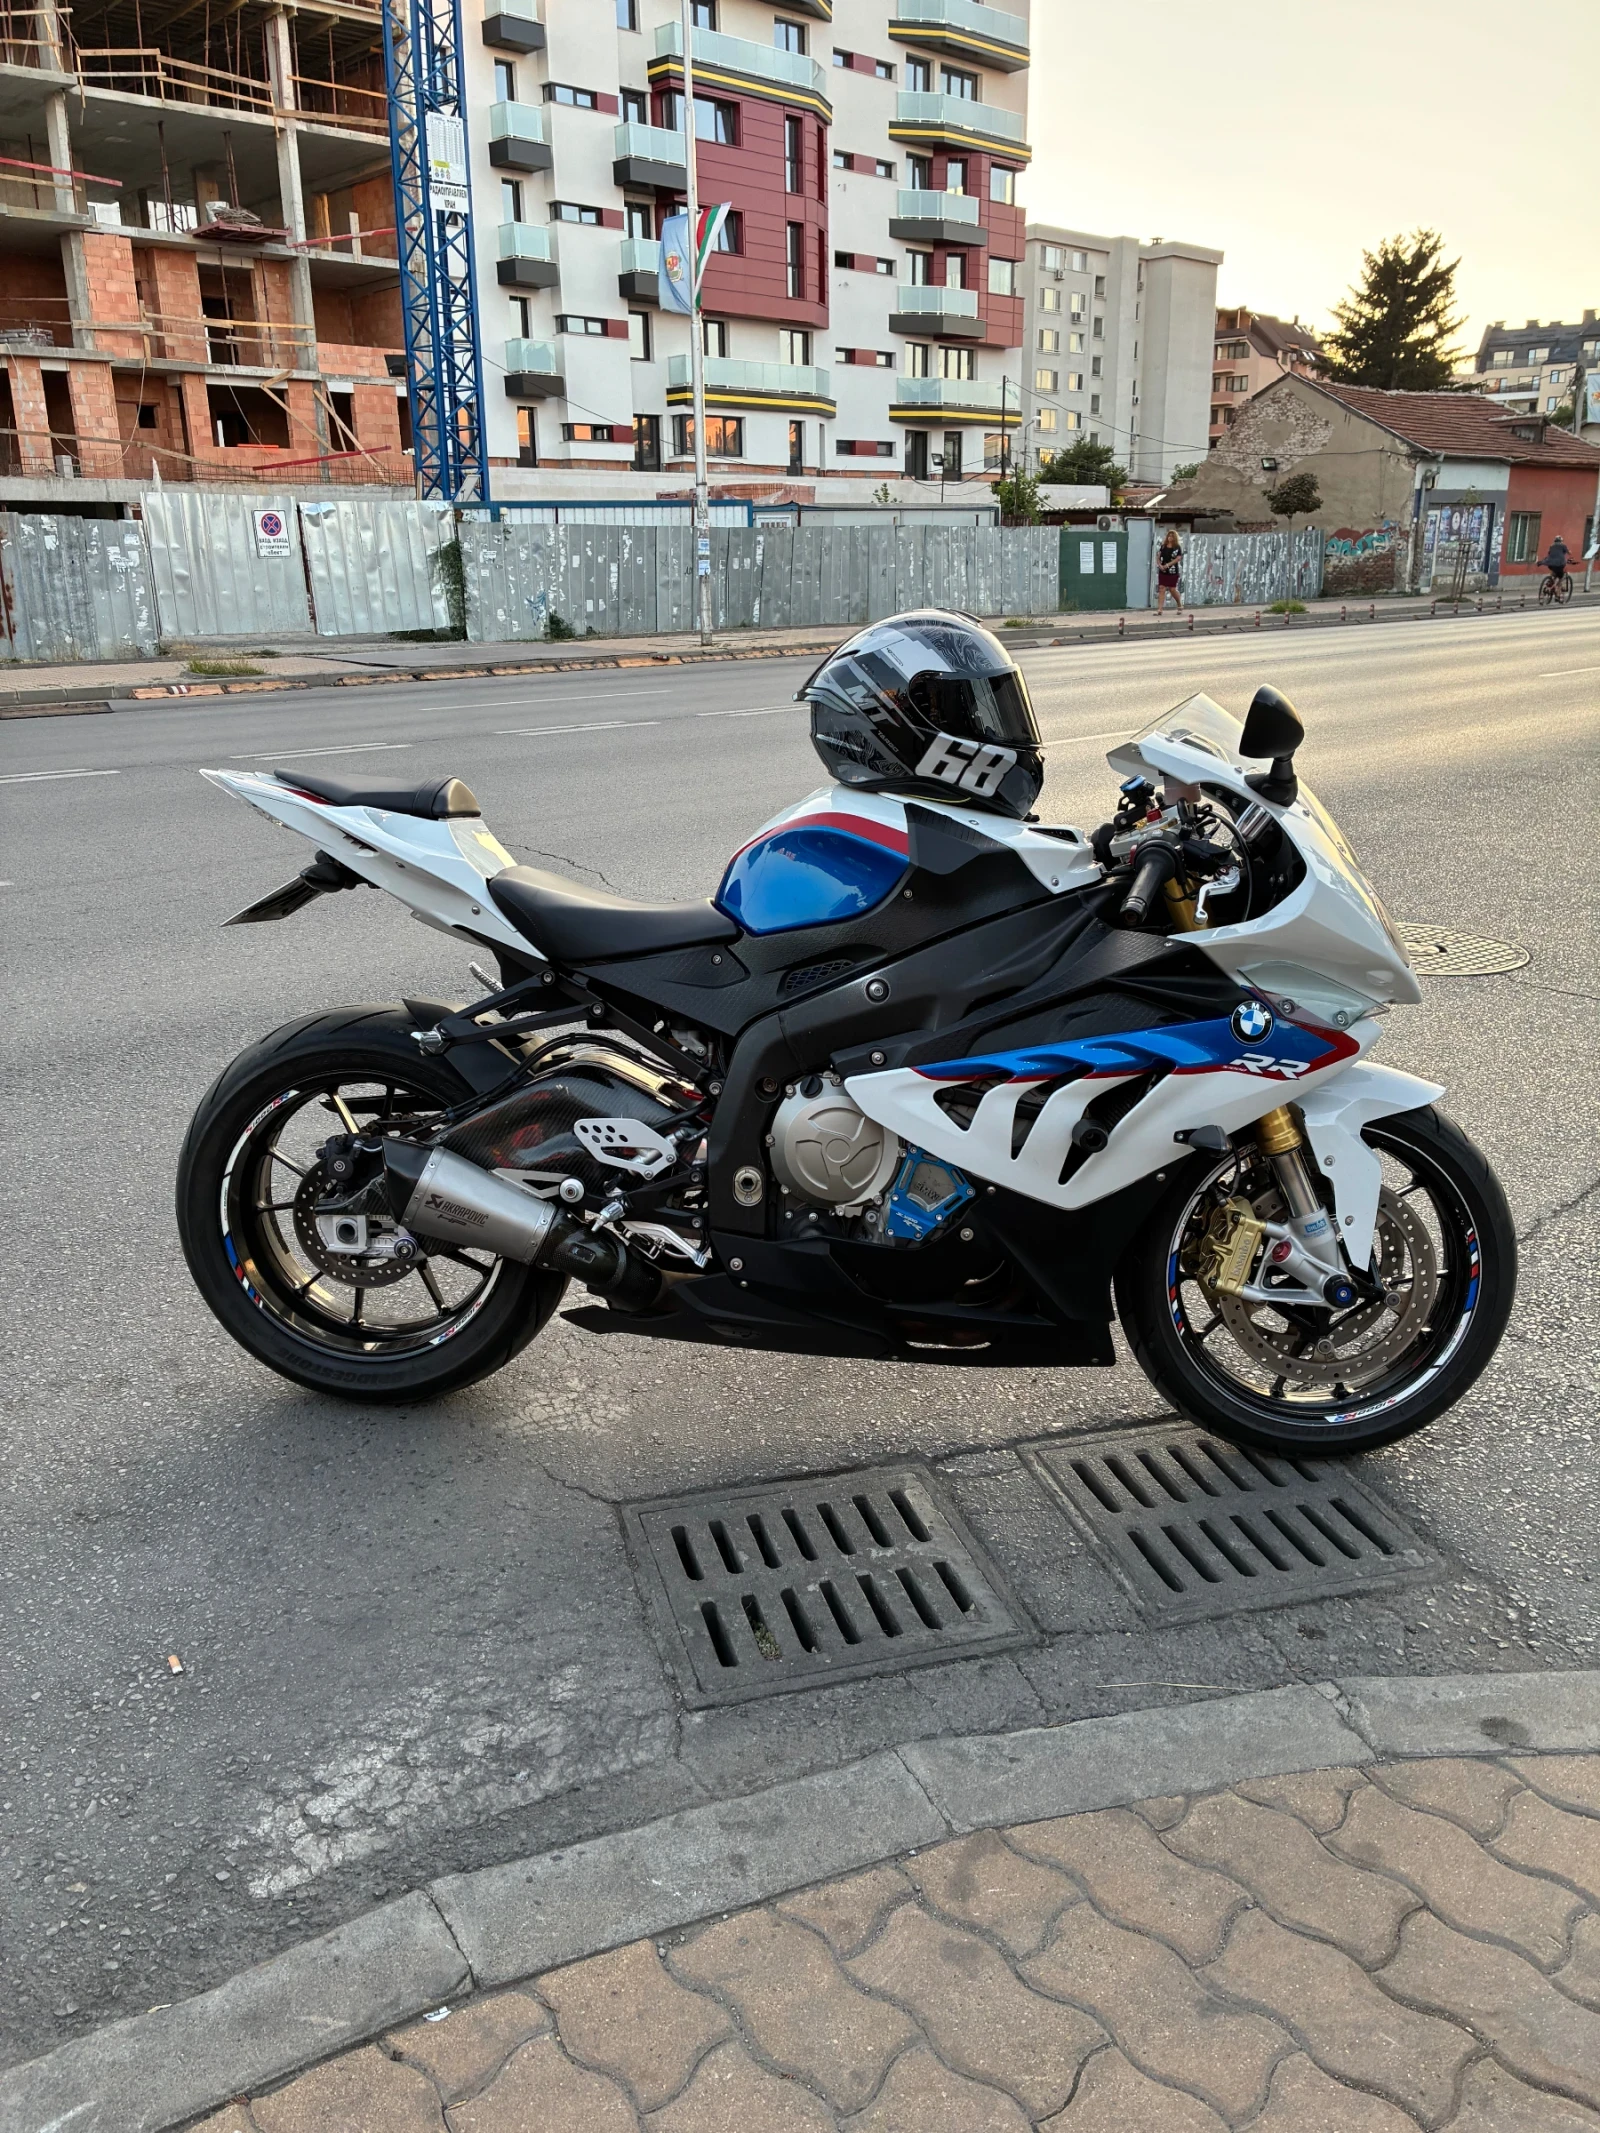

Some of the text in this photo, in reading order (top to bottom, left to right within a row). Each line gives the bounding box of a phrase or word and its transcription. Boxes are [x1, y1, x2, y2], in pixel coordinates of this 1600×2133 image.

[845, 684, 900, 728] MT
[914, 733, 1018, 798] 68
[1237, 1002, 1272, 1020] BMW
[1229, 1052, 1311, 1080] RR
[1231, 1238, 1252, 1276] brembo
